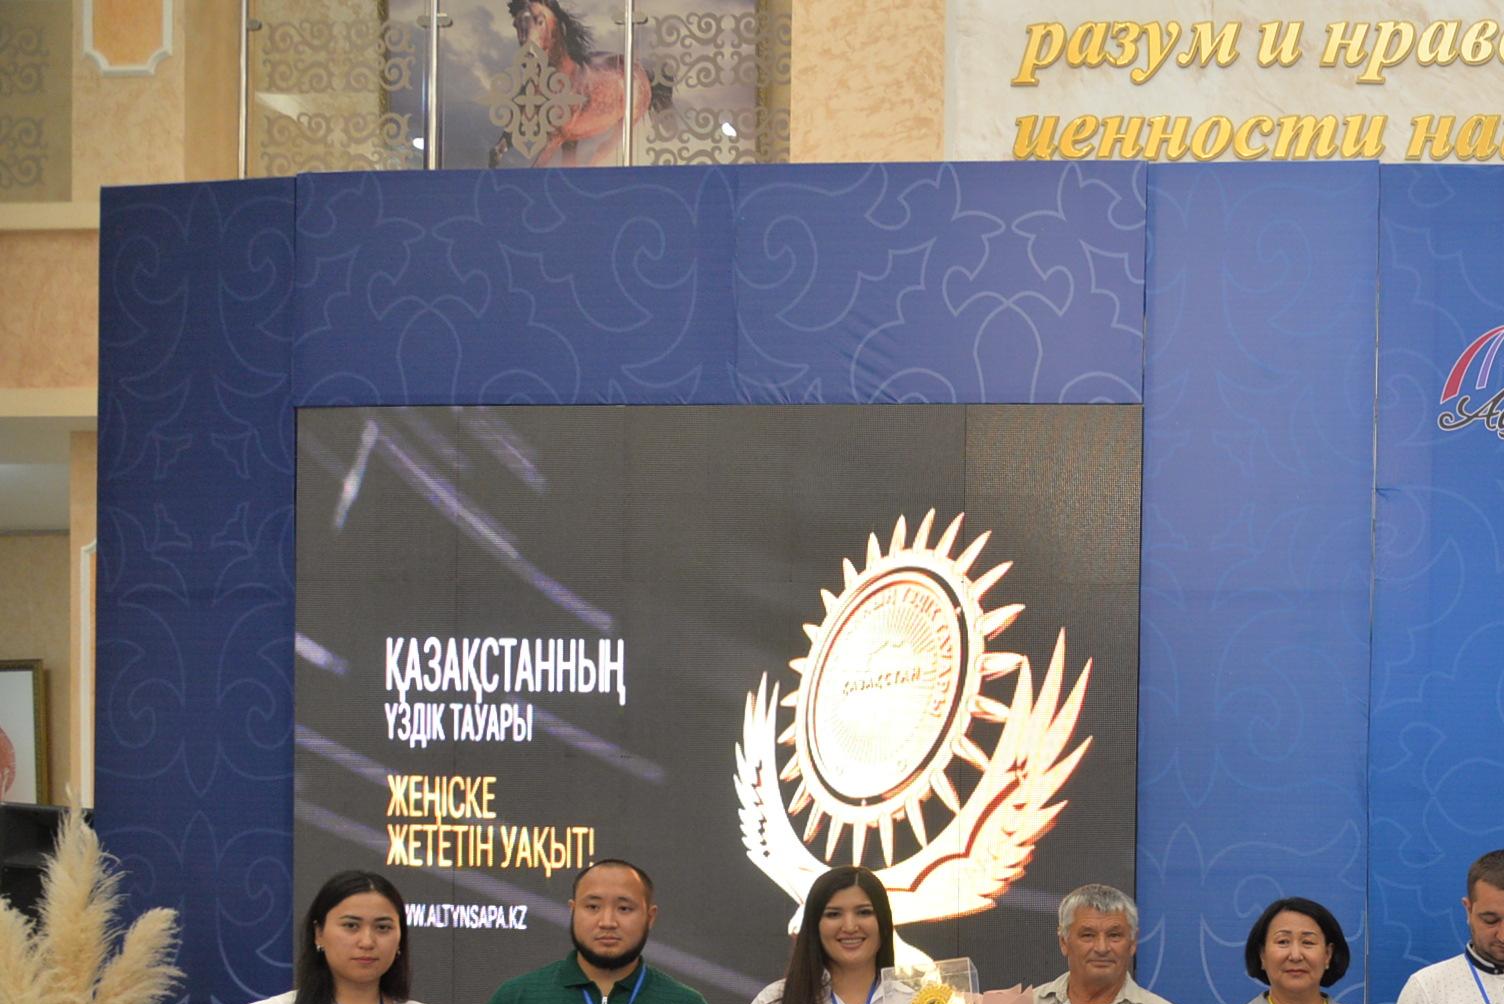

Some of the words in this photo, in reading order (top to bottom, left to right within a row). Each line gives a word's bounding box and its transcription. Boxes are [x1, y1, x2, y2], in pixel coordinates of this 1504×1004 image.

[1011, 20, 1241, 86] разум
[1257, 20, 1304, 67] и
[1013, 114, 1388, 161] ценности
[385, 636, 627, 706] ҚАЗАҚСТАННЫҢ
[384, 702, 446, 748] ҮЗДІК
[449, 703, 534, 742] ТАУАРЫ
[386, 774, 497, 827] ЖЕҢІСКЕ
[386, 823, 494, 868] ЖЕТЕТІН
[500, 825, 596, 878] УАҚЫТ!
